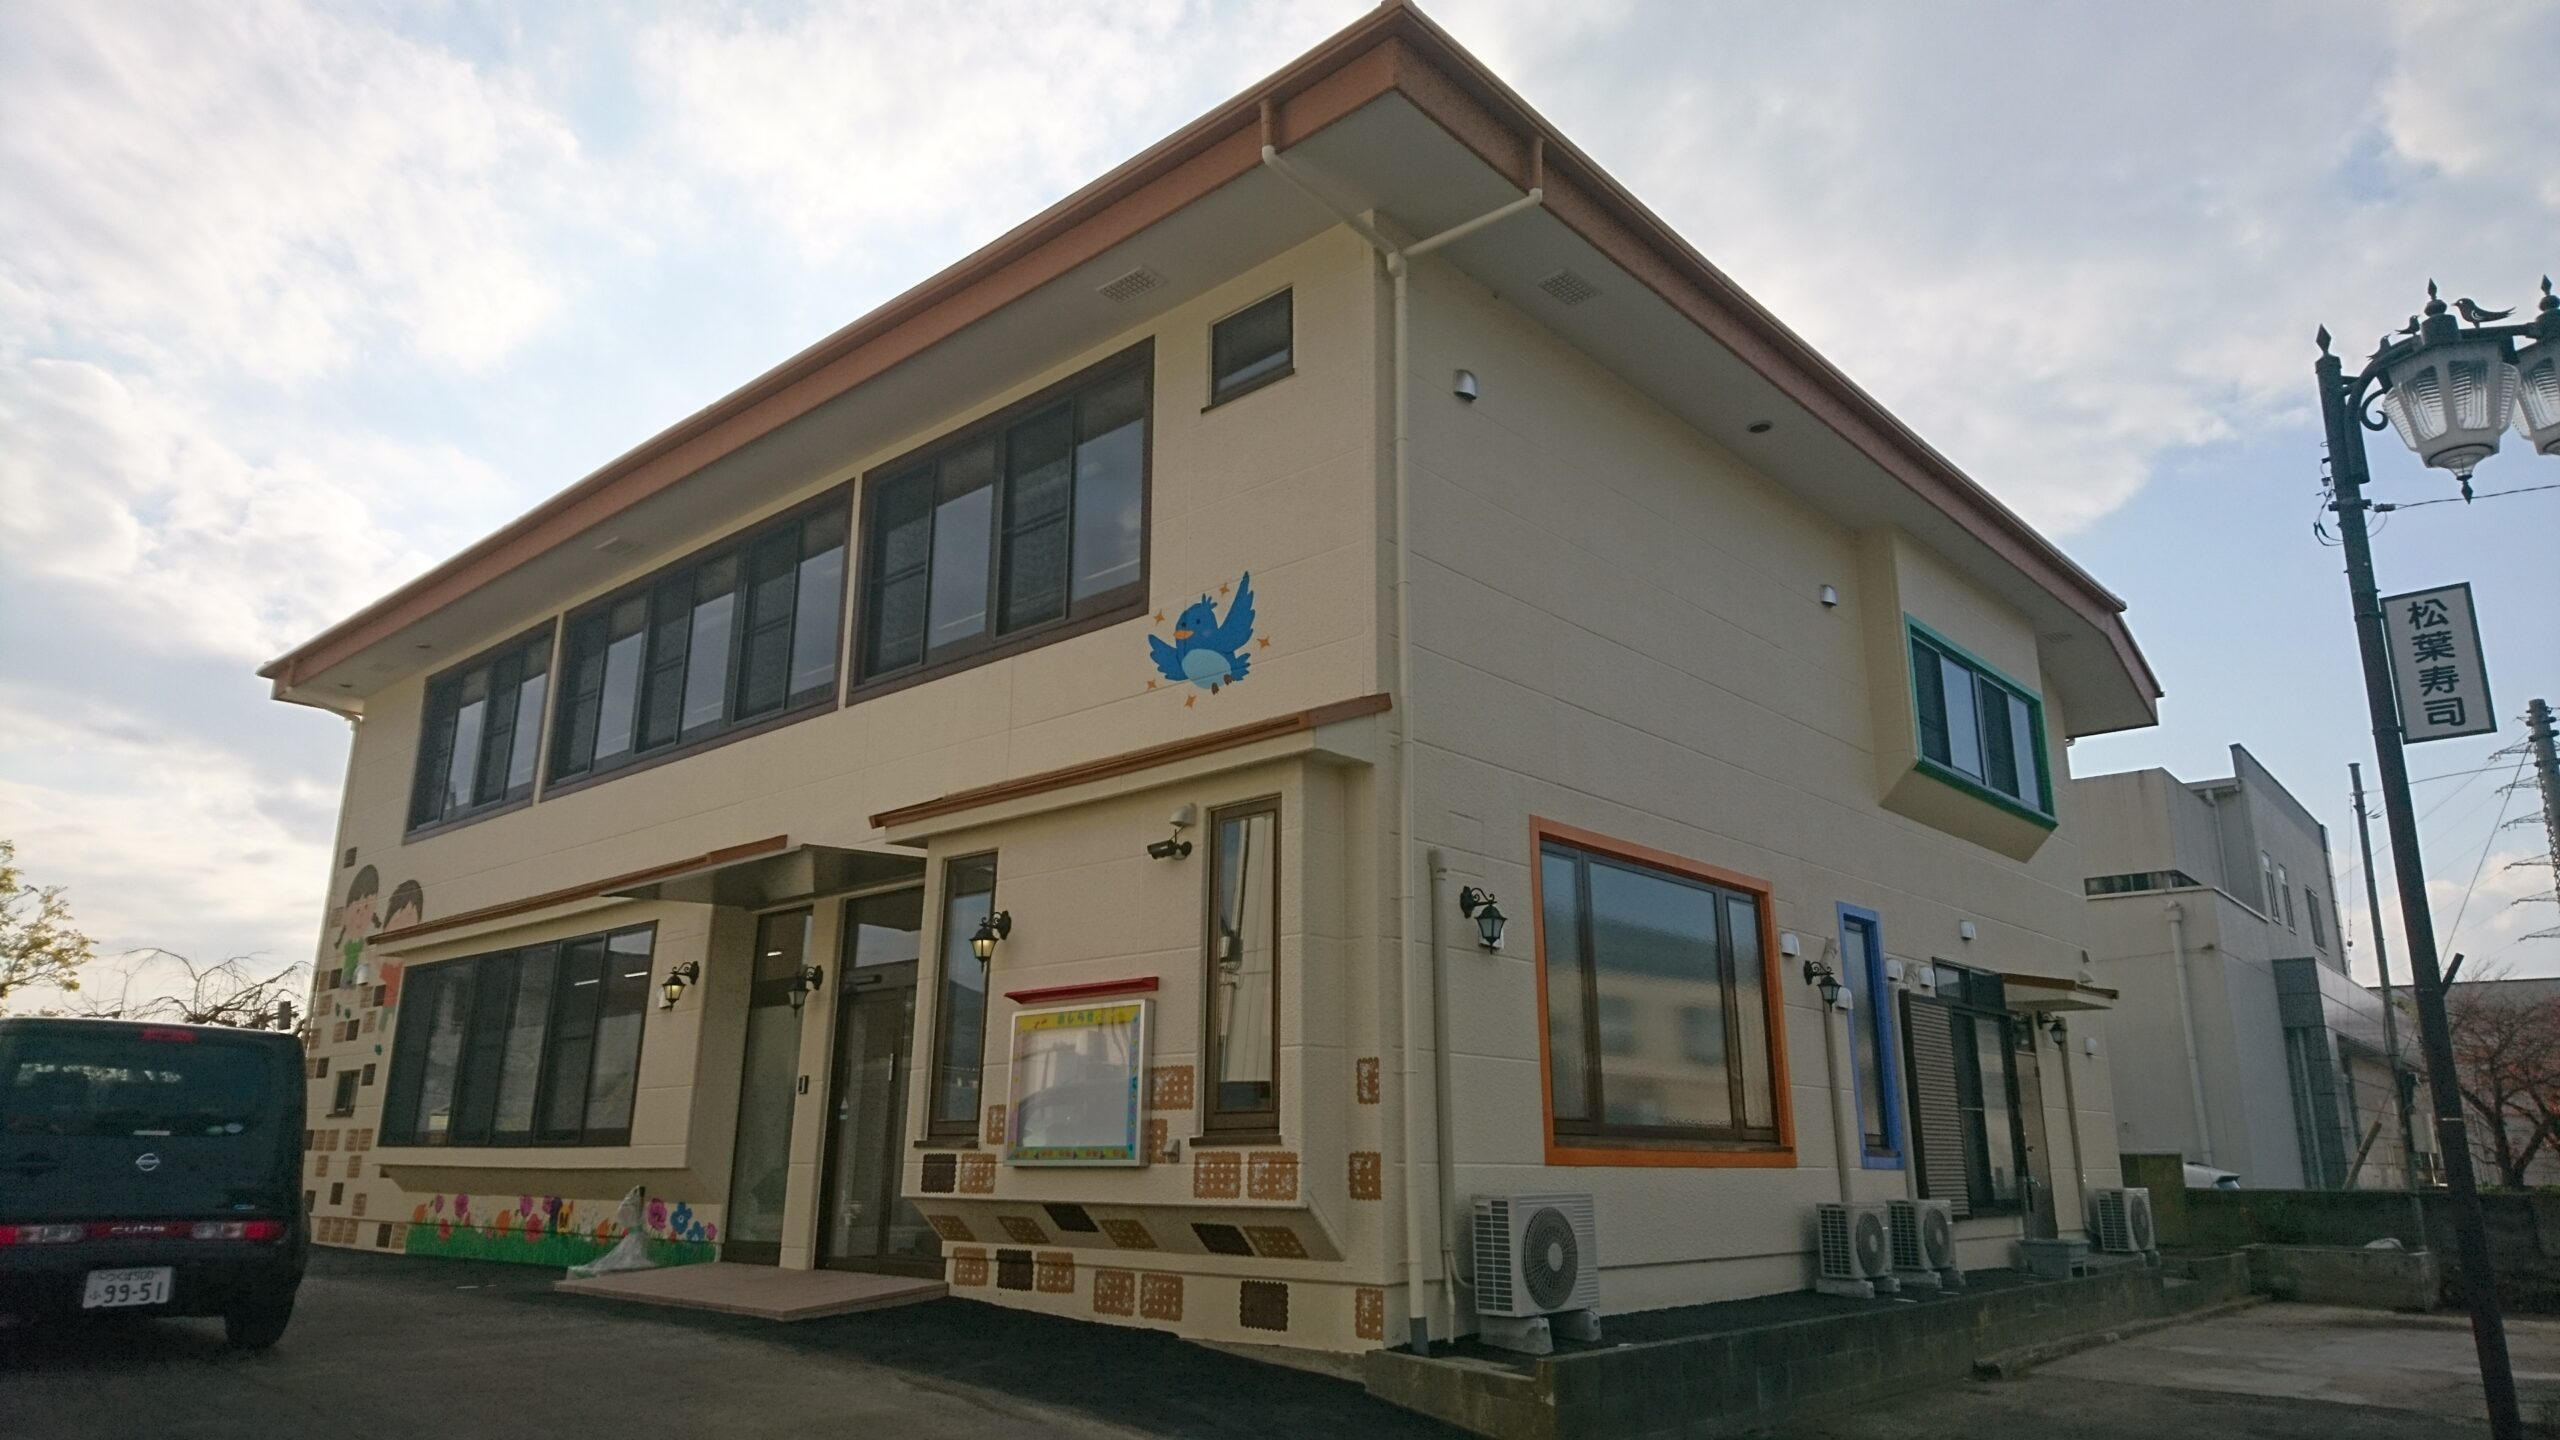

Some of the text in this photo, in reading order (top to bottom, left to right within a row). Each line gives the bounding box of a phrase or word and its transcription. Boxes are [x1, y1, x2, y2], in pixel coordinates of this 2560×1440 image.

[2407, 598, 2466, 726] 松葉寿司
[104, 1281, 162, 1303] 99-51
